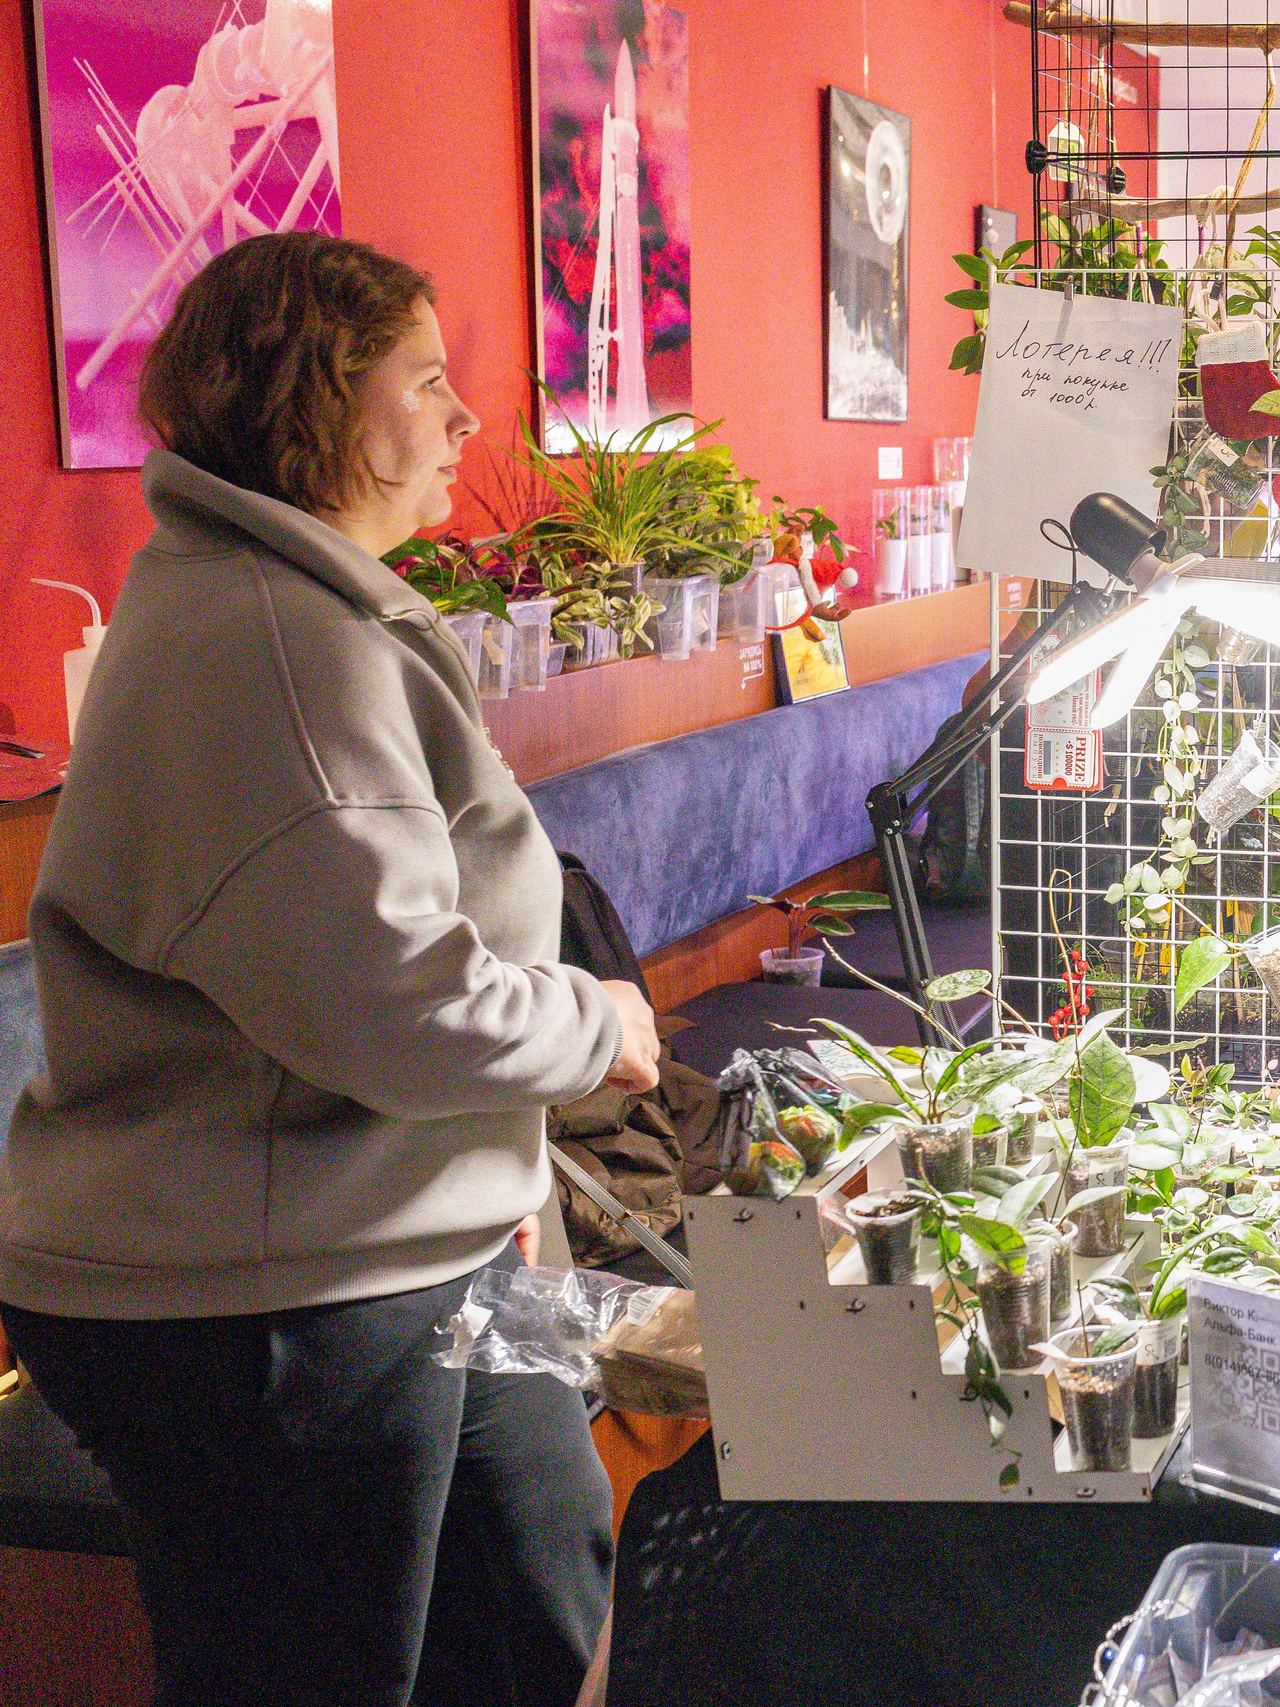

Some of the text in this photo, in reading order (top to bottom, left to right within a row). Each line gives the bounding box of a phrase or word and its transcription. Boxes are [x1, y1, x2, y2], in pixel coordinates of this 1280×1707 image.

[996, 320, 1172, 372] Лотерея!!!
[1021, 367, 1130, 396] при покупке
[1021, 389, 1036, 398] от
[1075, 736, 1087, 782] PRIZE
[1203, 1317, 1275, 1345] Альфа-Банк
